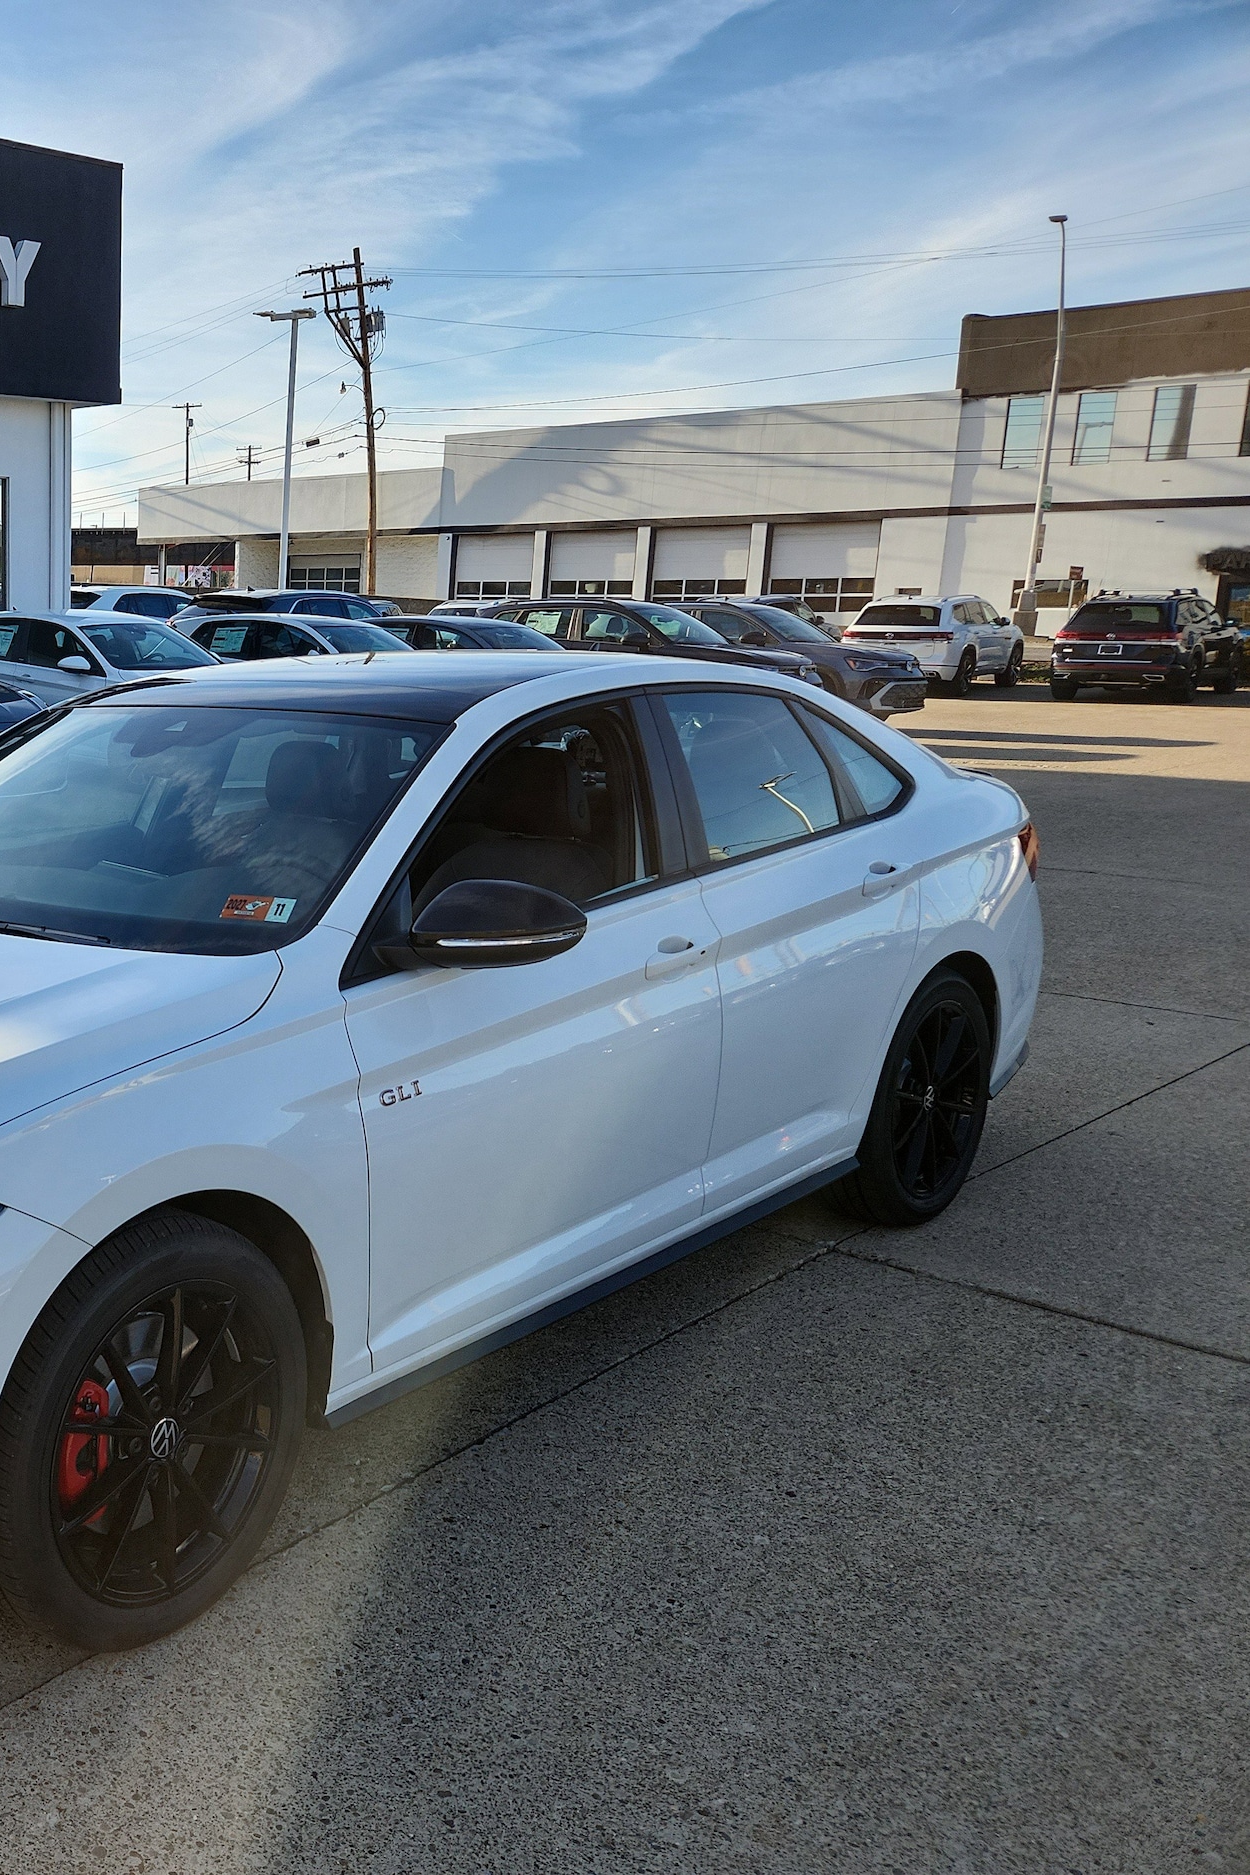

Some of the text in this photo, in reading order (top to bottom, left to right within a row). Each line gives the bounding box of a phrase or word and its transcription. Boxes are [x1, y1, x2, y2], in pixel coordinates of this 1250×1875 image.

[226, 898, 248, 911] 2027
[273, 903, 287, 917] 11
[379, 1079, 423, 1107] GLI
